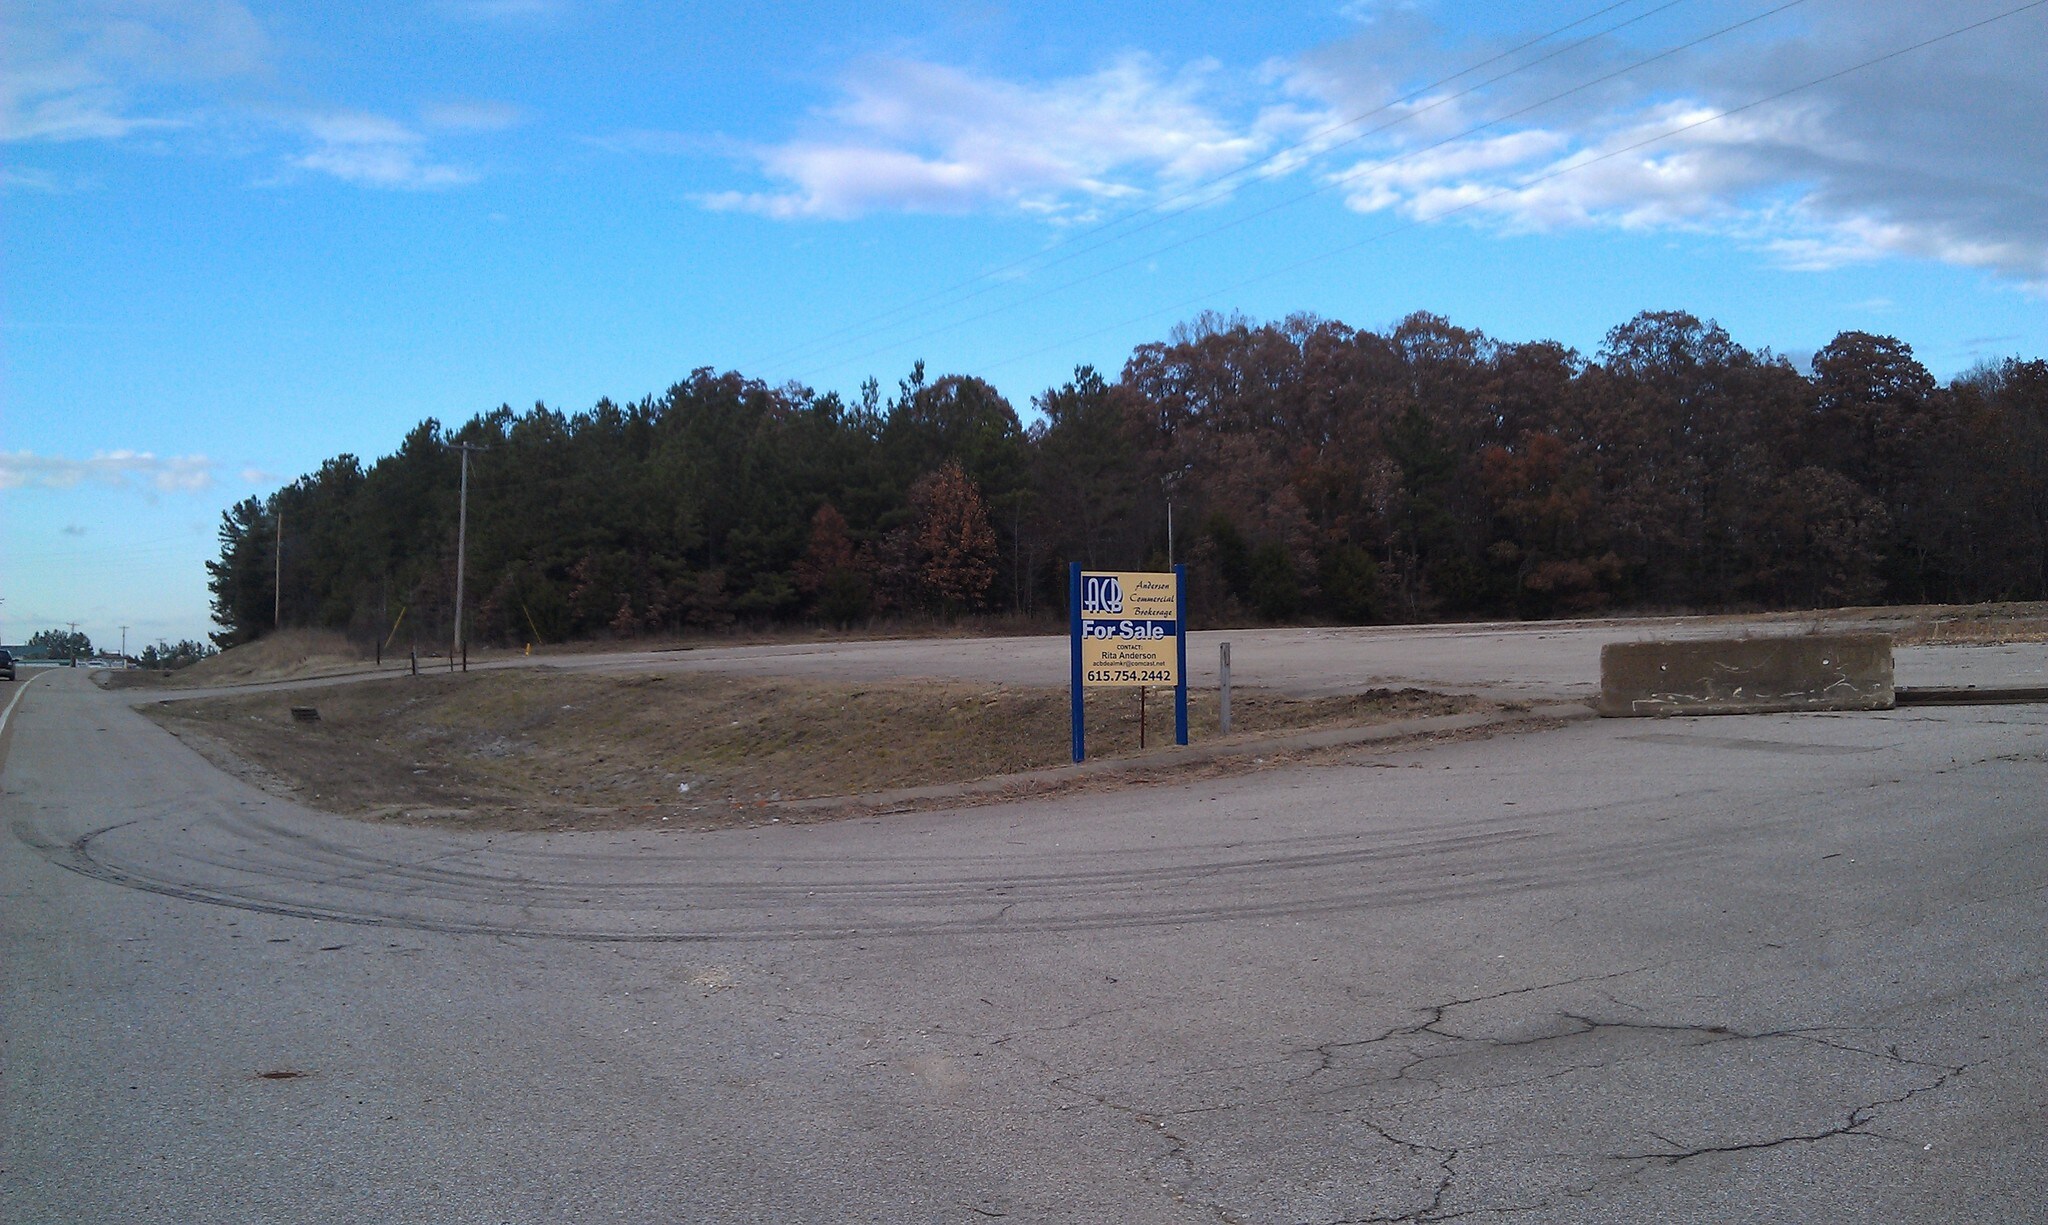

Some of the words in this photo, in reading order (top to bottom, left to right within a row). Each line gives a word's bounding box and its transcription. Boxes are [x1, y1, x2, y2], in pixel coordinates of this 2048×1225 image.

[1129, 593, 1175, 603] Commercial
[1133, 606, 1172, 618] Brokerage
[1082, 620, 1116, 640] For
[1119, 620, 1165, 640] Sale
[1101, 651, 1117, 660] Rita
[1119, 651, 1157, 660] Anderson
[1087, 670, 1171, 682] 615.754.2442
